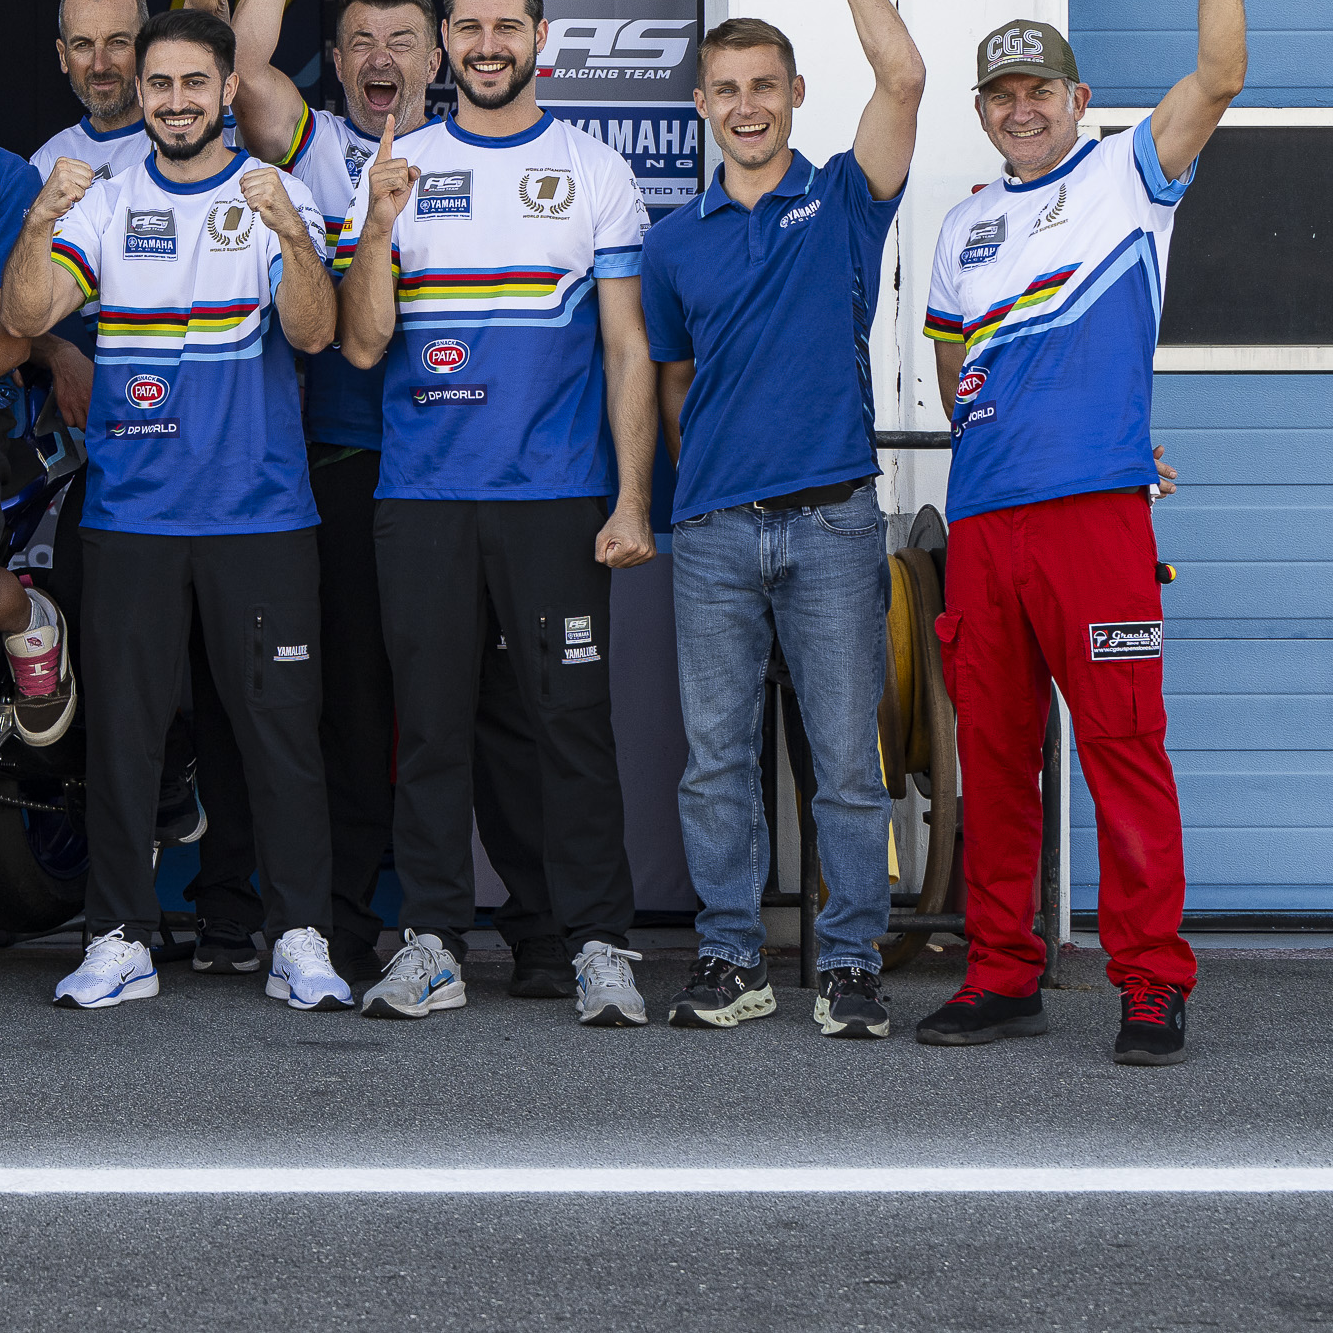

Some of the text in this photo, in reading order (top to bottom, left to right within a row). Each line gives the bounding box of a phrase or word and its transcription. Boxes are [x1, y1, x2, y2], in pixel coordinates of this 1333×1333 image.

[537, 18, 698, 67] AS
[986, 28, 1044, 62] CGS
[553, 68, 672, 80] RACING TEAM
[425, 175, 466, 191] AS
[535, 175, 561, 200] 1
[430, 198, 467, 209] YAMAHA
[786, 198, 822, 222] YAMAHA
[223, 205, 245, 231] 1
[137, 238, 174, 250] YAMAHA
[432, 349, 459, 363] PATA
[134, 384, 159, 398] PATA
[957, 376, 983, 394] PATA
[428, 389, 485, 401] DP WORLD
[127, 422, 177, 434] DP WORLD
[1108, 629, 1150, 647] Gracia
[564, 645, 598, 659] YAMALUBE
